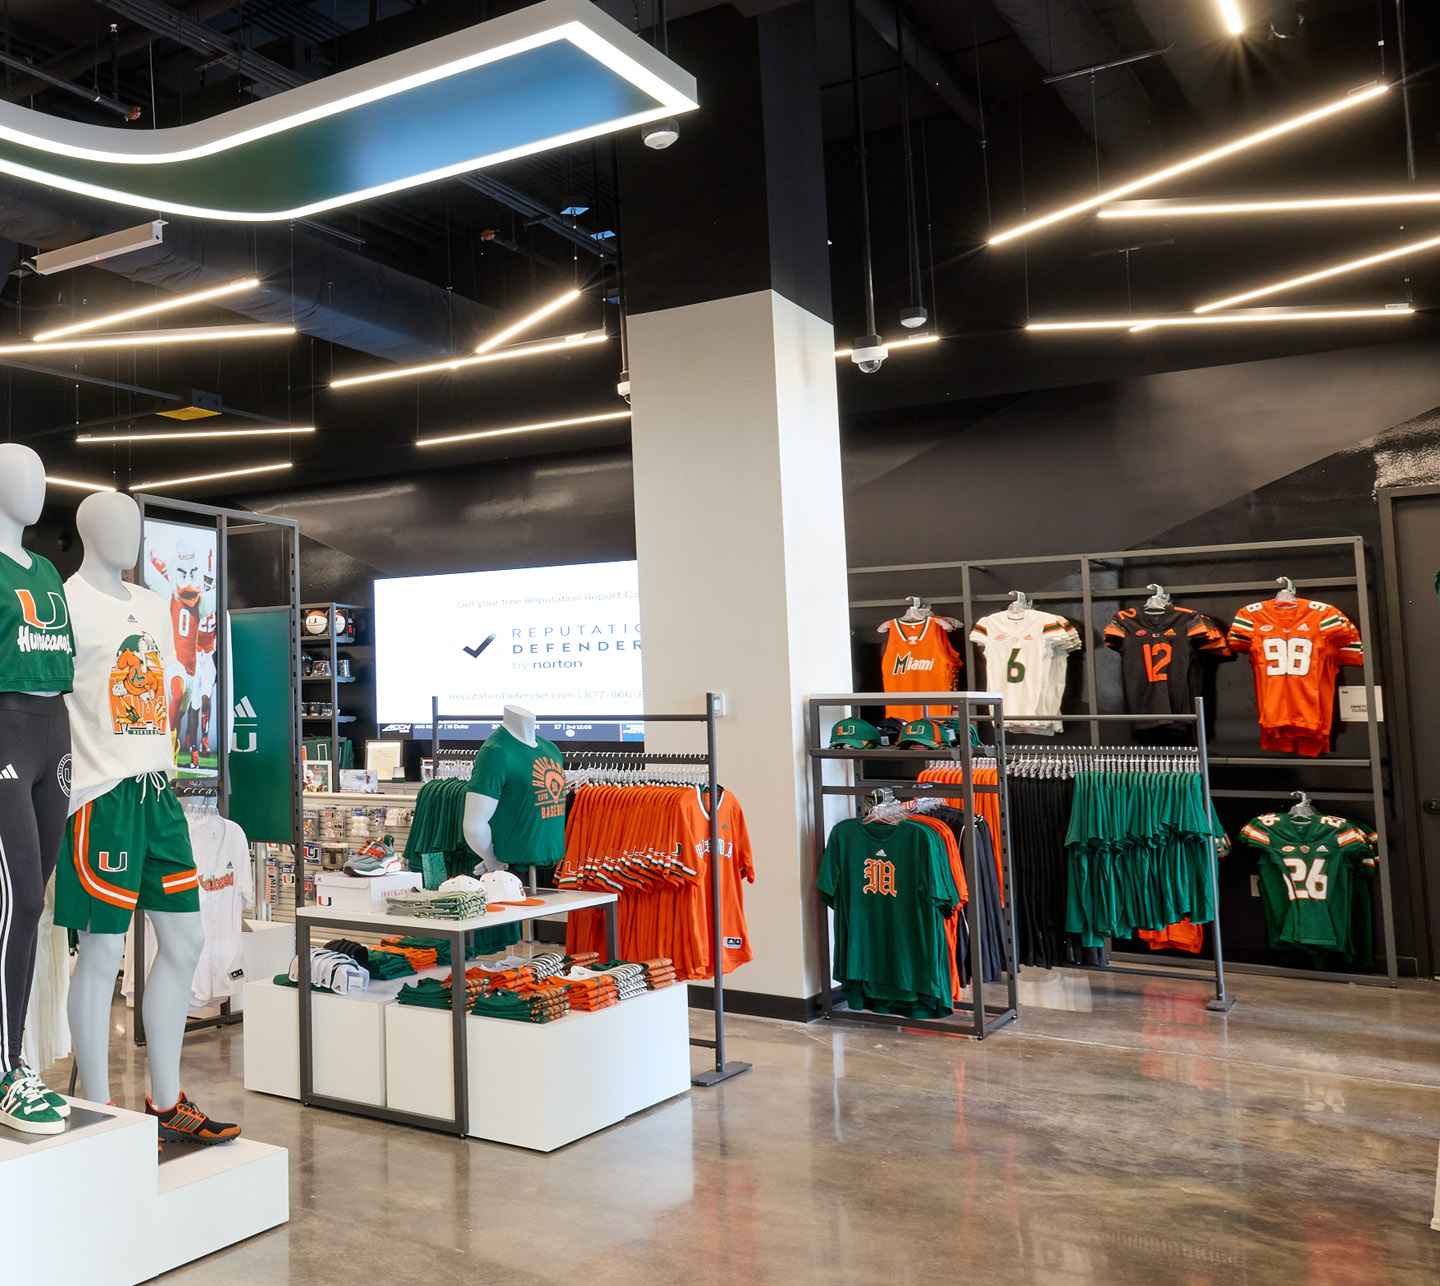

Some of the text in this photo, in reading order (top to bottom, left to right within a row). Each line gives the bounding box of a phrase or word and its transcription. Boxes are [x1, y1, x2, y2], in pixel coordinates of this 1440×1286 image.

[15, 589, 68, 630] U
[456, 600, 475, 608] Get
[477, 600, 499, 609] your
[501, 598, 520, 606] free
[524, 594, 581, 605] Reputation
[584, 592, 620, 602] Report
[178, 608, 190, 637] 0
[513, 640, 642, 654] DEFENDER
[1262, 637, 1313, 676] 98
[533, 659, 583, 669] norton
[893, 650, 935, 675] Miami
[1006, 647, 1025, 684] 6
[1143, 642, 1172, 683] 12
[98, 851, 128, 872] U
